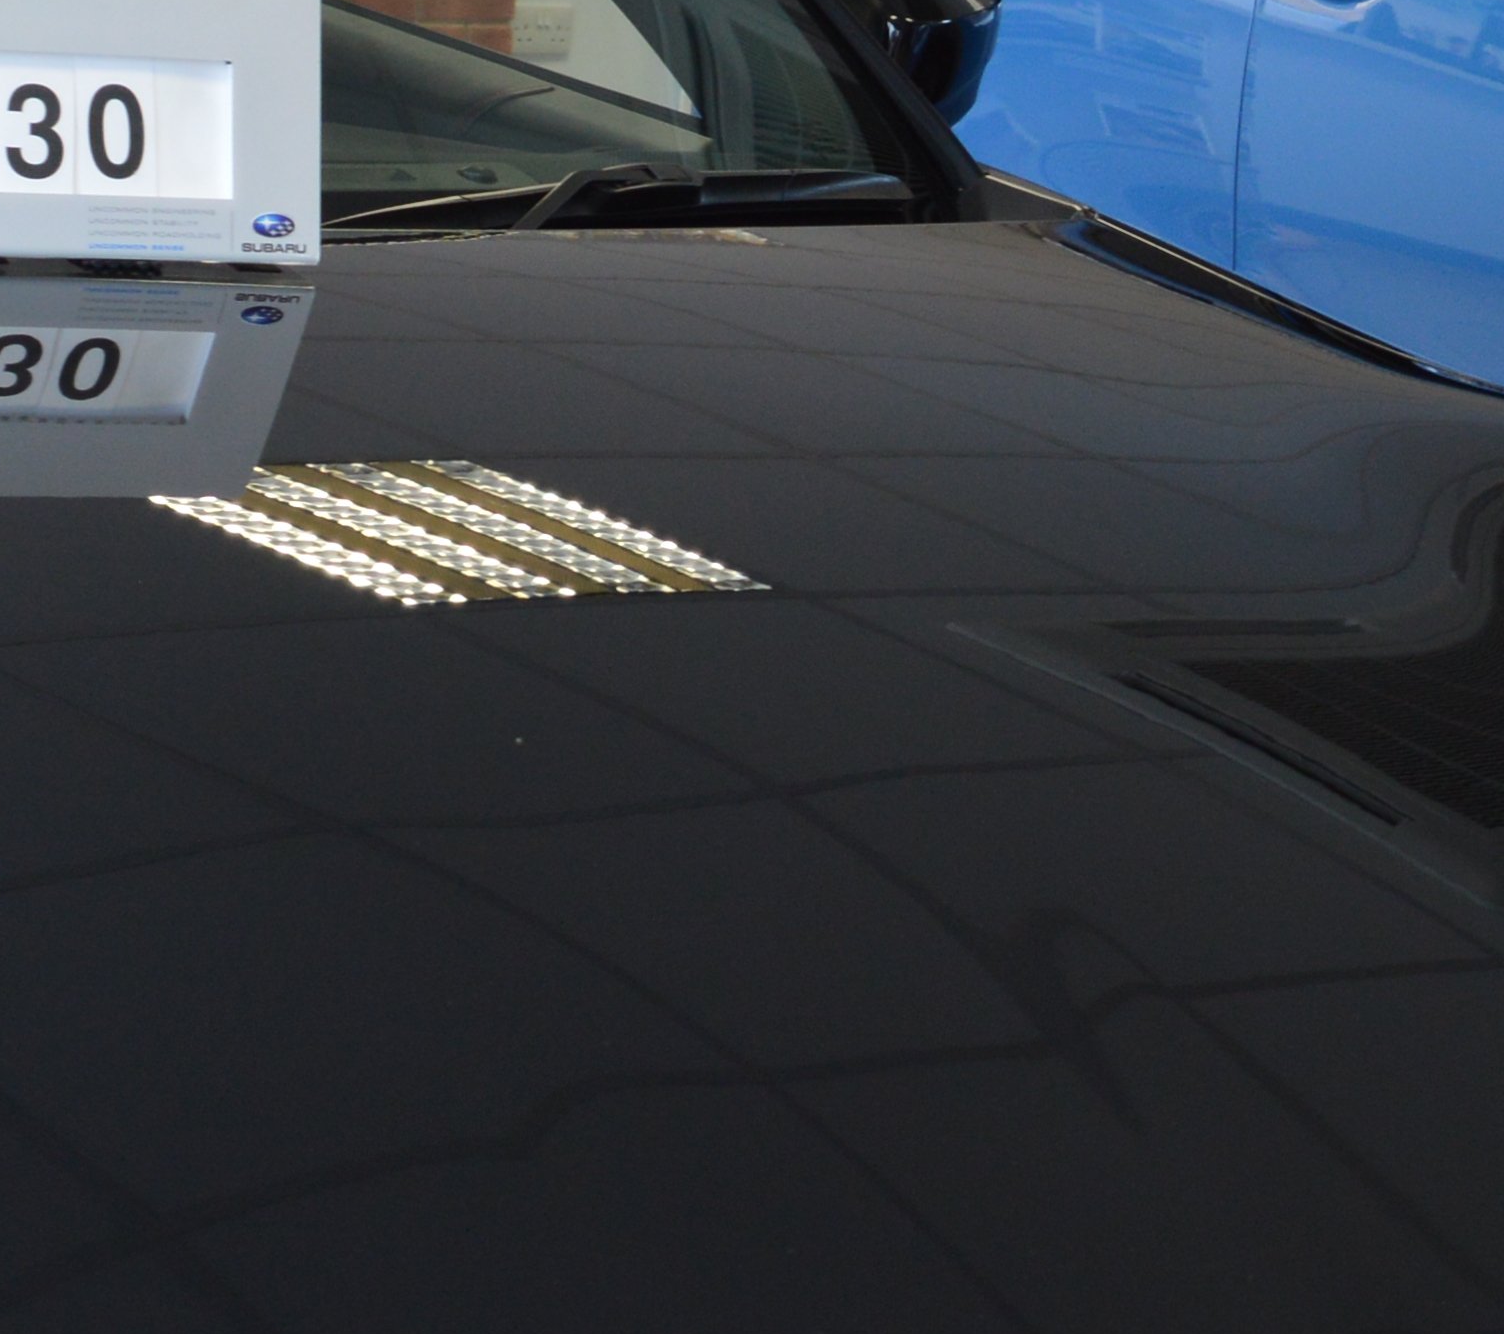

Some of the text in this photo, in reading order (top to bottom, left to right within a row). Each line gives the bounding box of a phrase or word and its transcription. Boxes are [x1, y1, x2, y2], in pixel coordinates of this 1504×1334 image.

[88, 206, 147, 214] UNCOMMON
[88, 218, 147, 226] UNCOMMON
[88, 230, 147, 238] UNCOMMON
[88, 243, 147, 251] UNCOMMON
[241, 243, 307, 254] SUBARU
